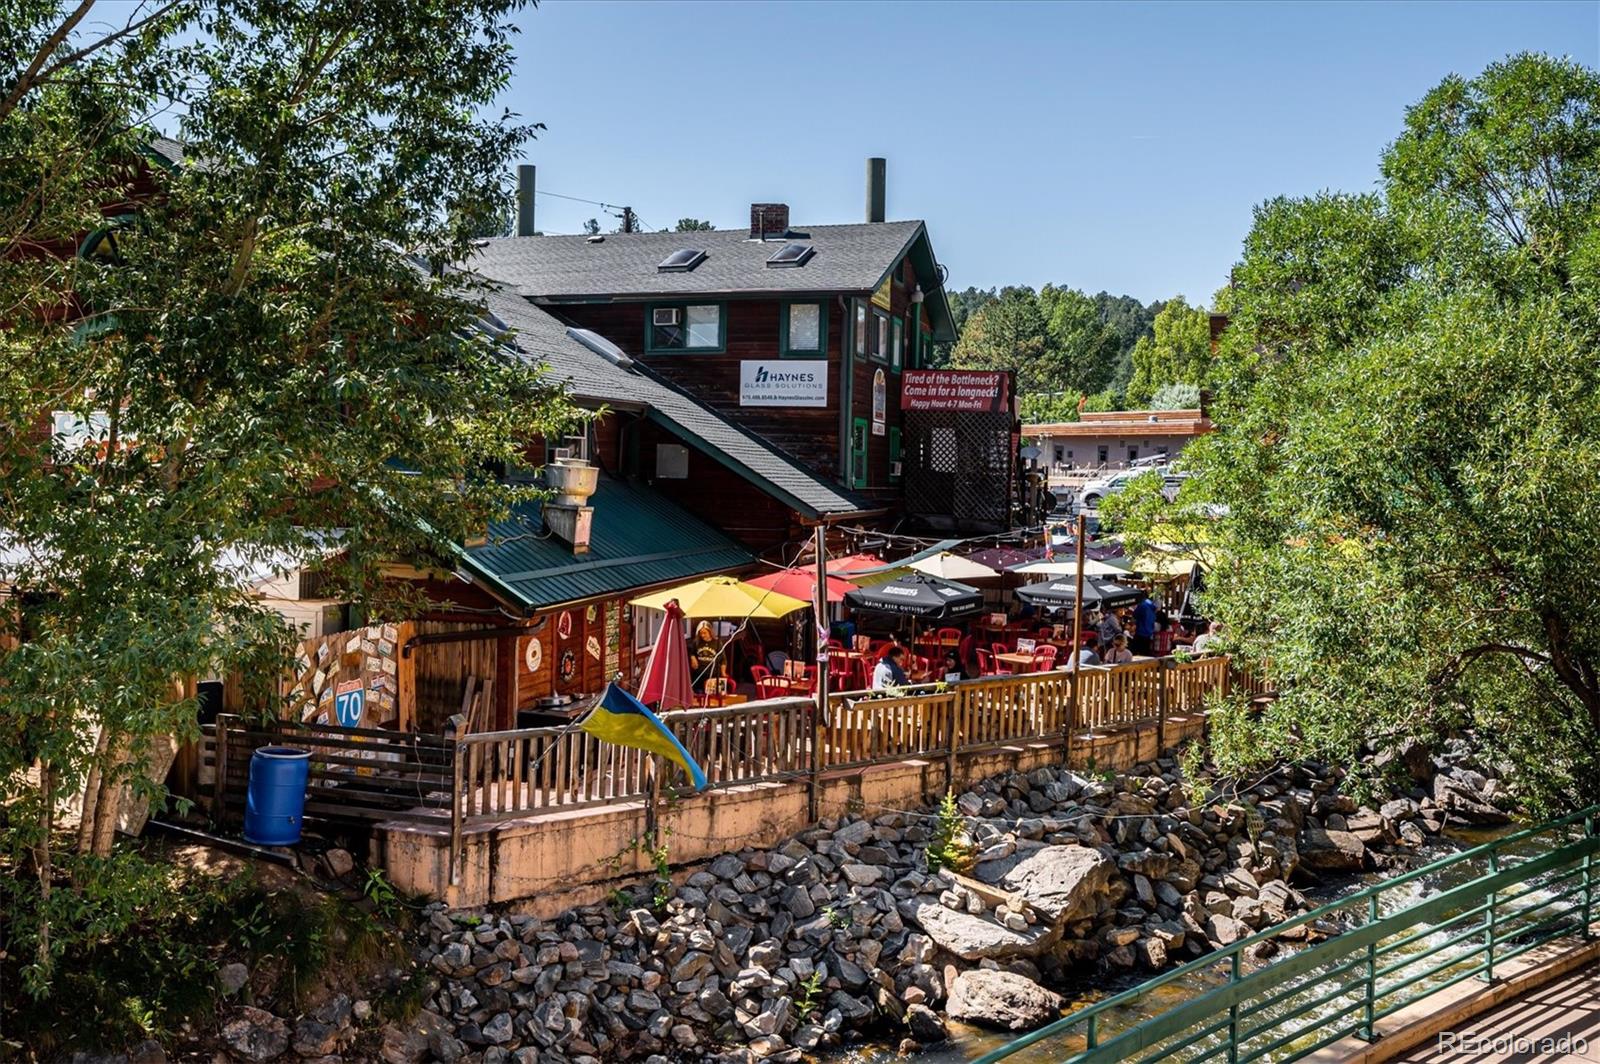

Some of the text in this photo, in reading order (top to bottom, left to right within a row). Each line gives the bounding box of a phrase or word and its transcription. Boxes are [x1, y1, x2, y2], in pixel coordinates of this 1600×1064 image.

[770, 373, 814, 382] HAYNES
[904, 373, 1000, 386] Tired of the Bottleneck?
[904, 385, 927, 396] Come
[928, 385, 937, 395] in
[938, 385, 950, 396] for
[957, 386, 999, 399] longneck!
[910, 399, 982, 409] Happy Hour 4-7 Mon-Fri
[338, 692, 361, 724] 70
